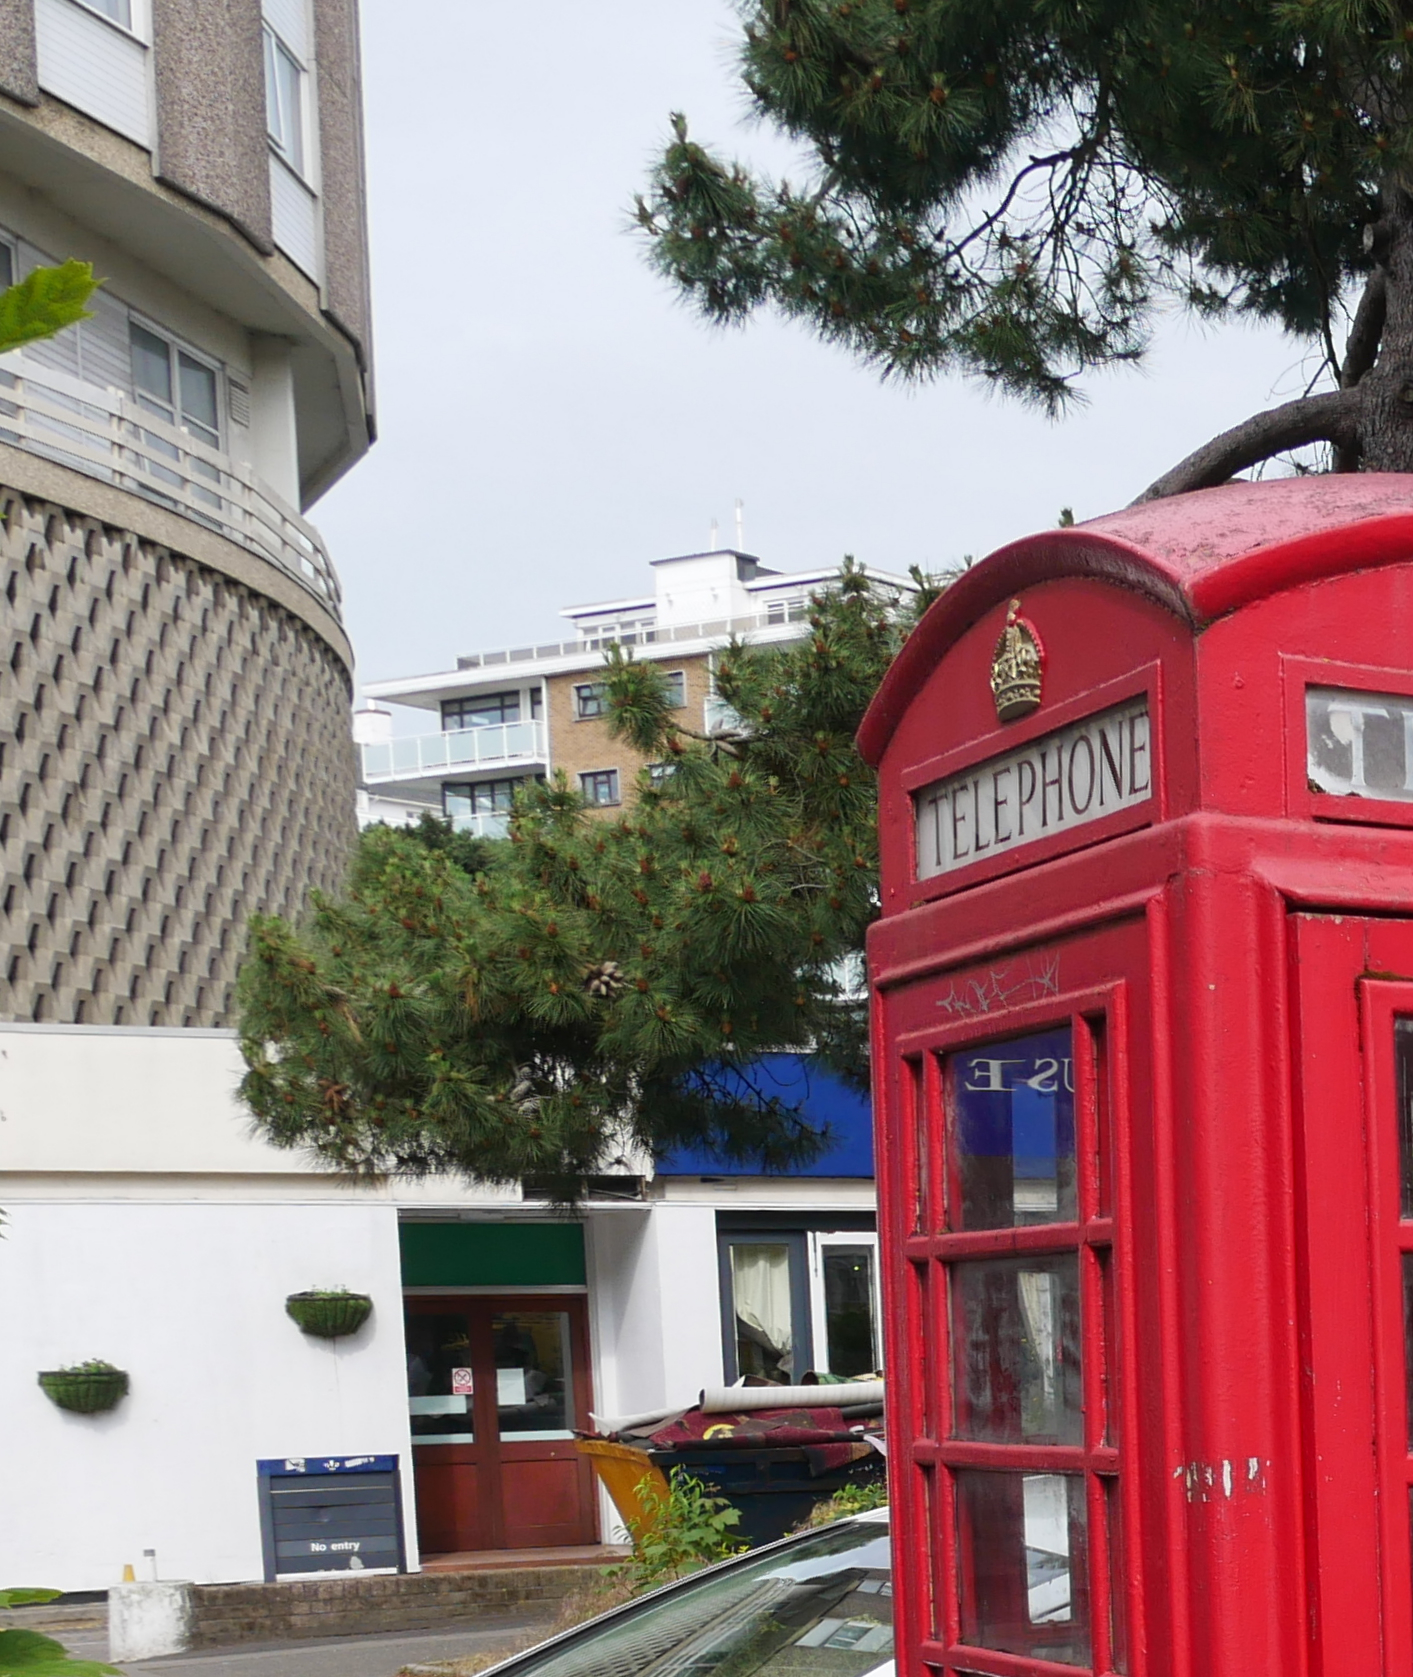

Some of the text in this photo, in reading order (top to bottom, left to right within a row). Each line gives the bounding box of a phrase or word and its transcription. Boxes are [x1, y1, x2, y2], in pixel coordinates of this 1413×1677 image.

[928, 709, 1150, 868] TELEPHONE
[310, 1541, 361, 1552] No entry
